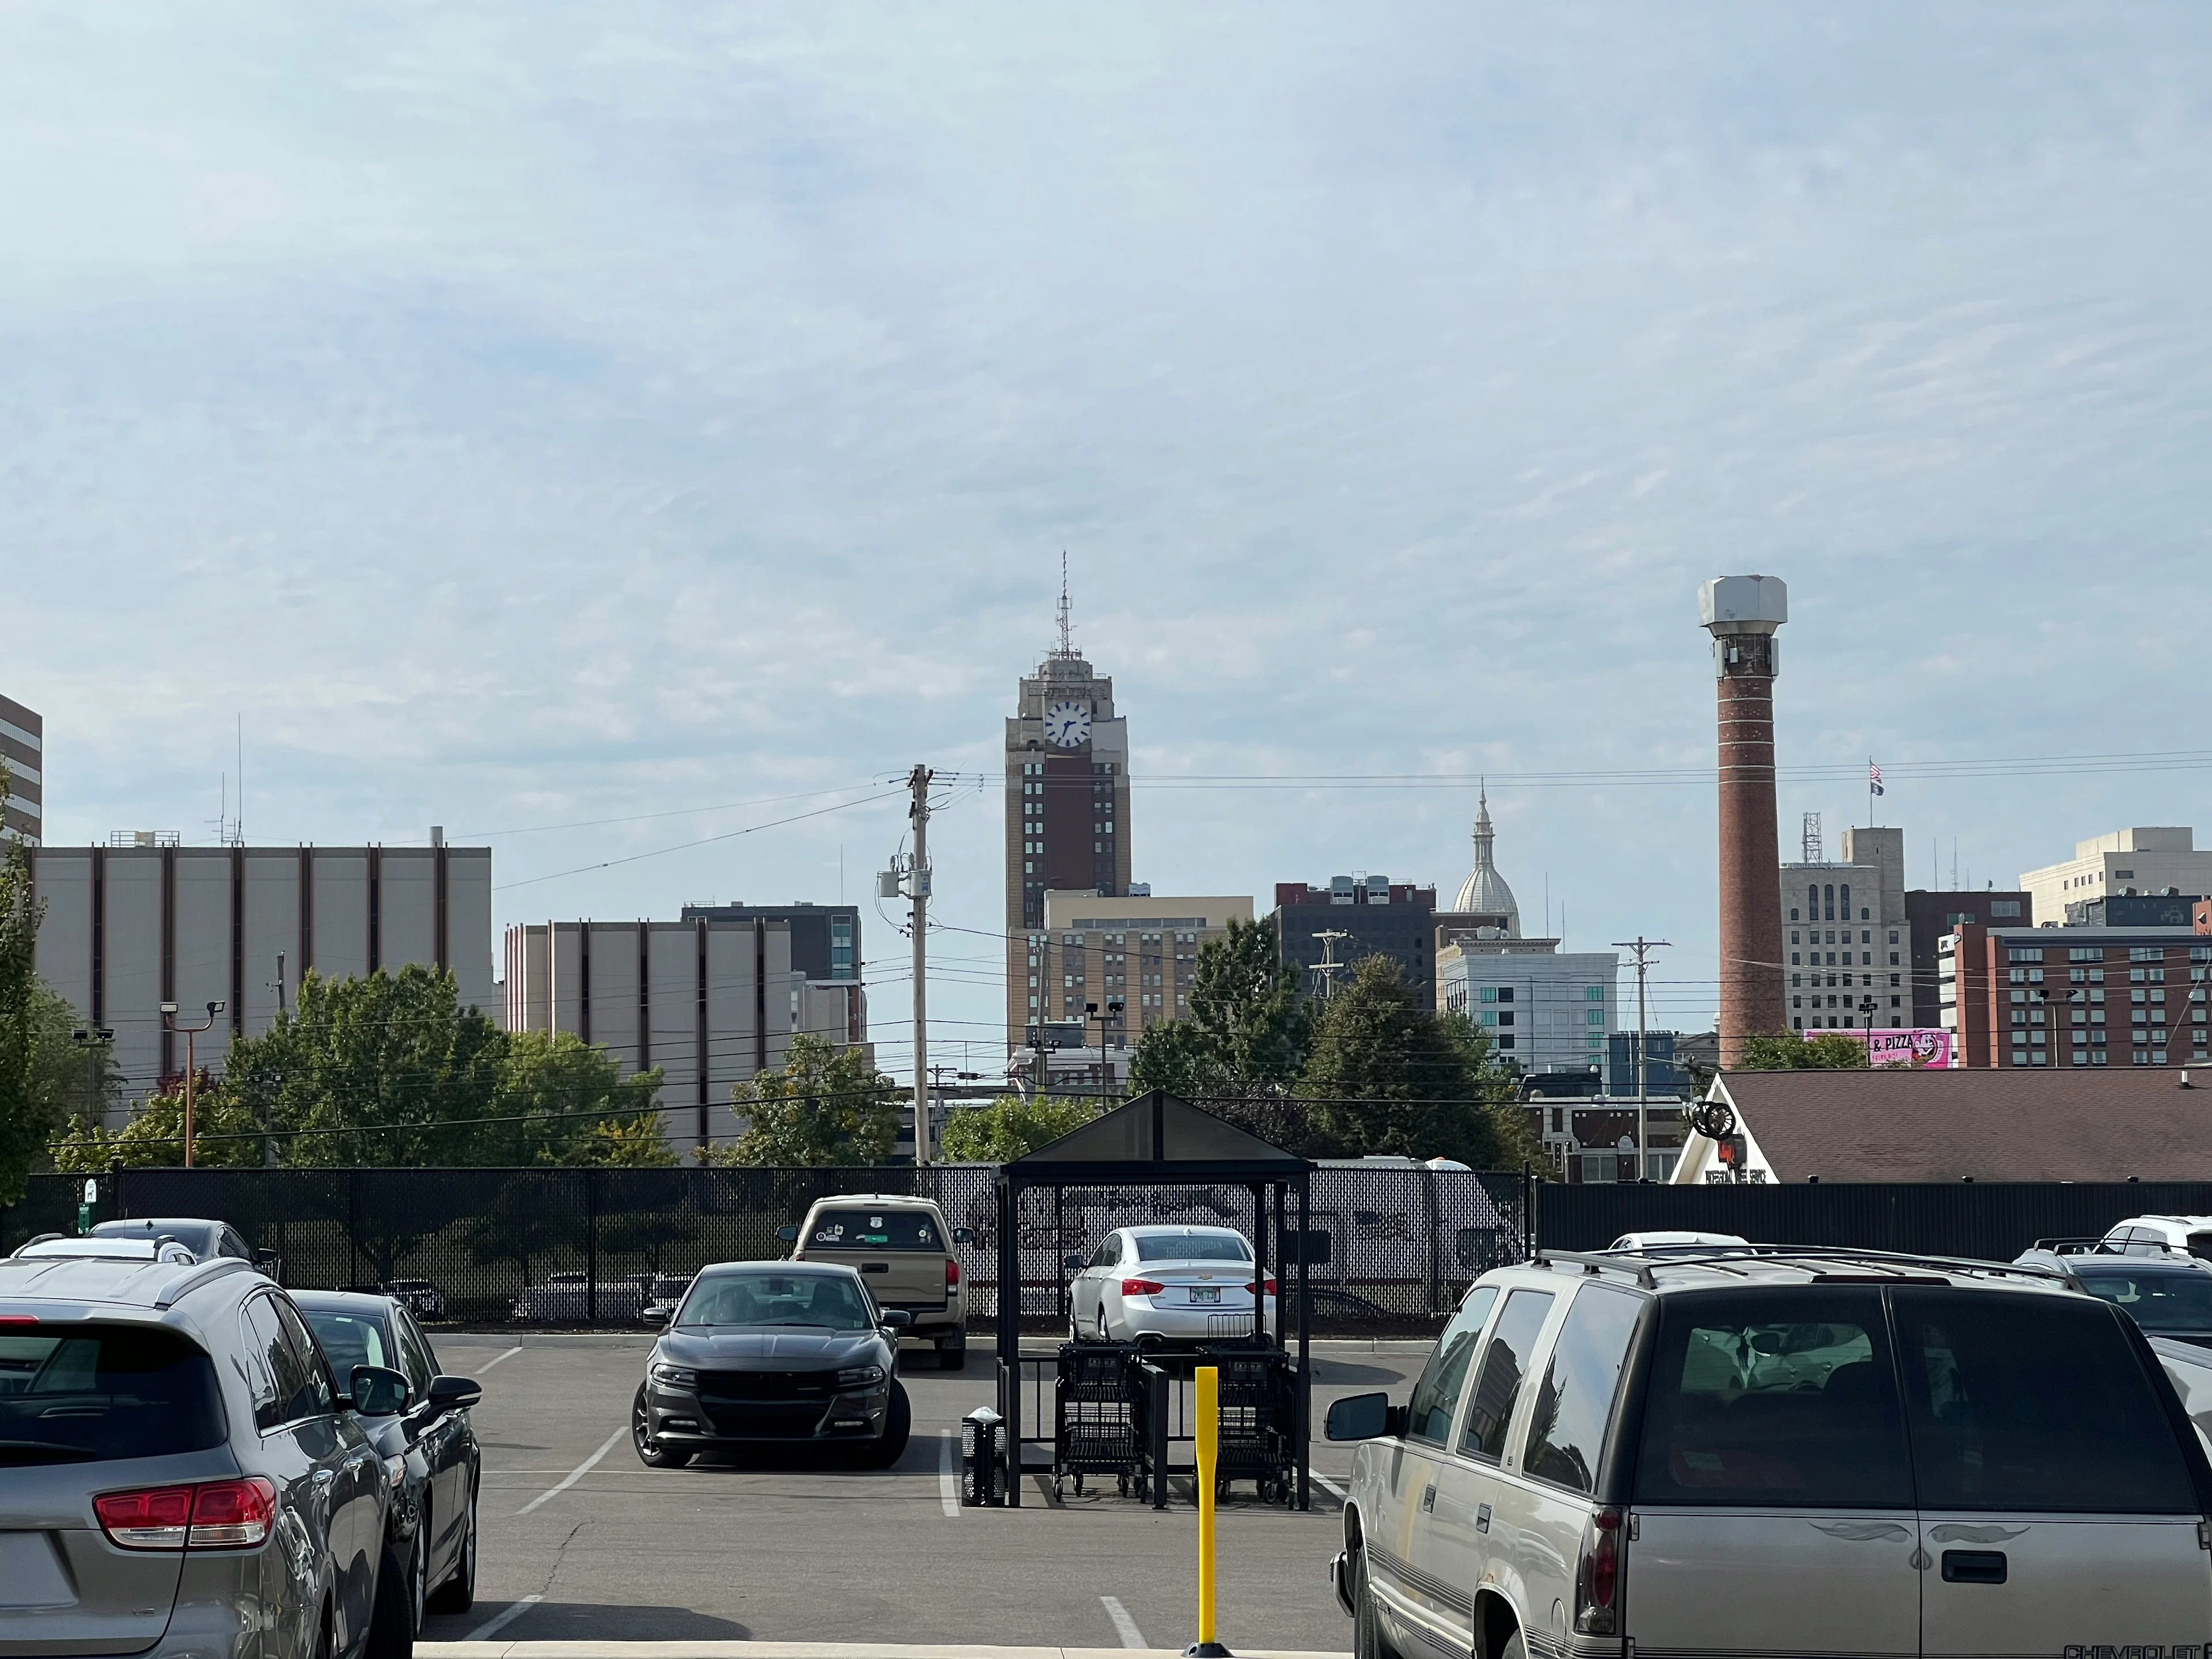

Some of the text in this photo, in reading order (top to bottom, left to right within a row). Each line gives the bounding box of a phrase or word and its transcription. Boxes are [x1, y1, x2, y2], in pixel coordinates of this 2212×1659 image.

[1874, 1035, 1912, 1052] & PIZZA
[2064, 1645, 2200, 1659] CHEVROLET
